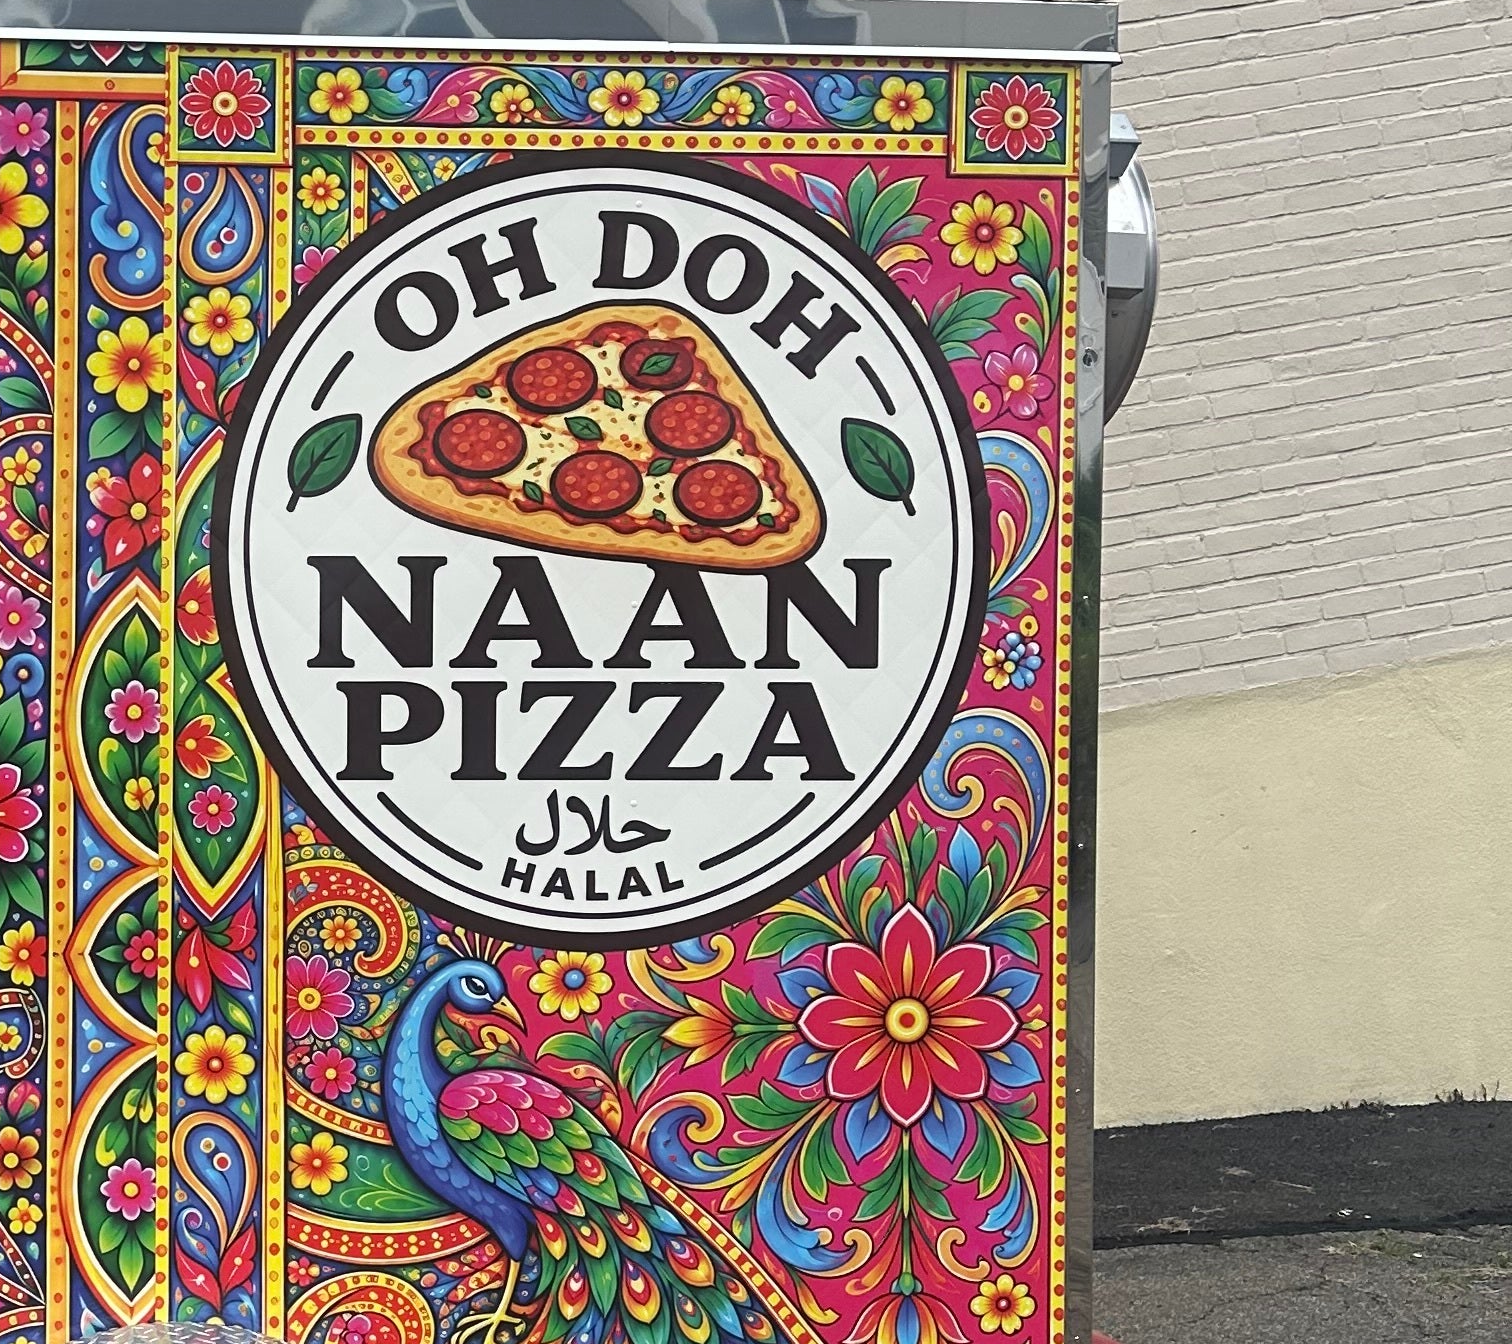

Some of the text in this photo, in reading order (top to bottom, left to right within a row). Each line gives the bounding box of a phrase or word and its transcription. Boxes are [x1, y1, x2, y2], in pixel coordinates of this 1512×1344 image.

[373, 210, 862, 380] OH DOH
[306, 555, 893, 670] NAAN
[335, 680, 856, 782] PIZZA
[515, 788, 672, 857] حلال
[500, 856, 685, 902] HALAL
